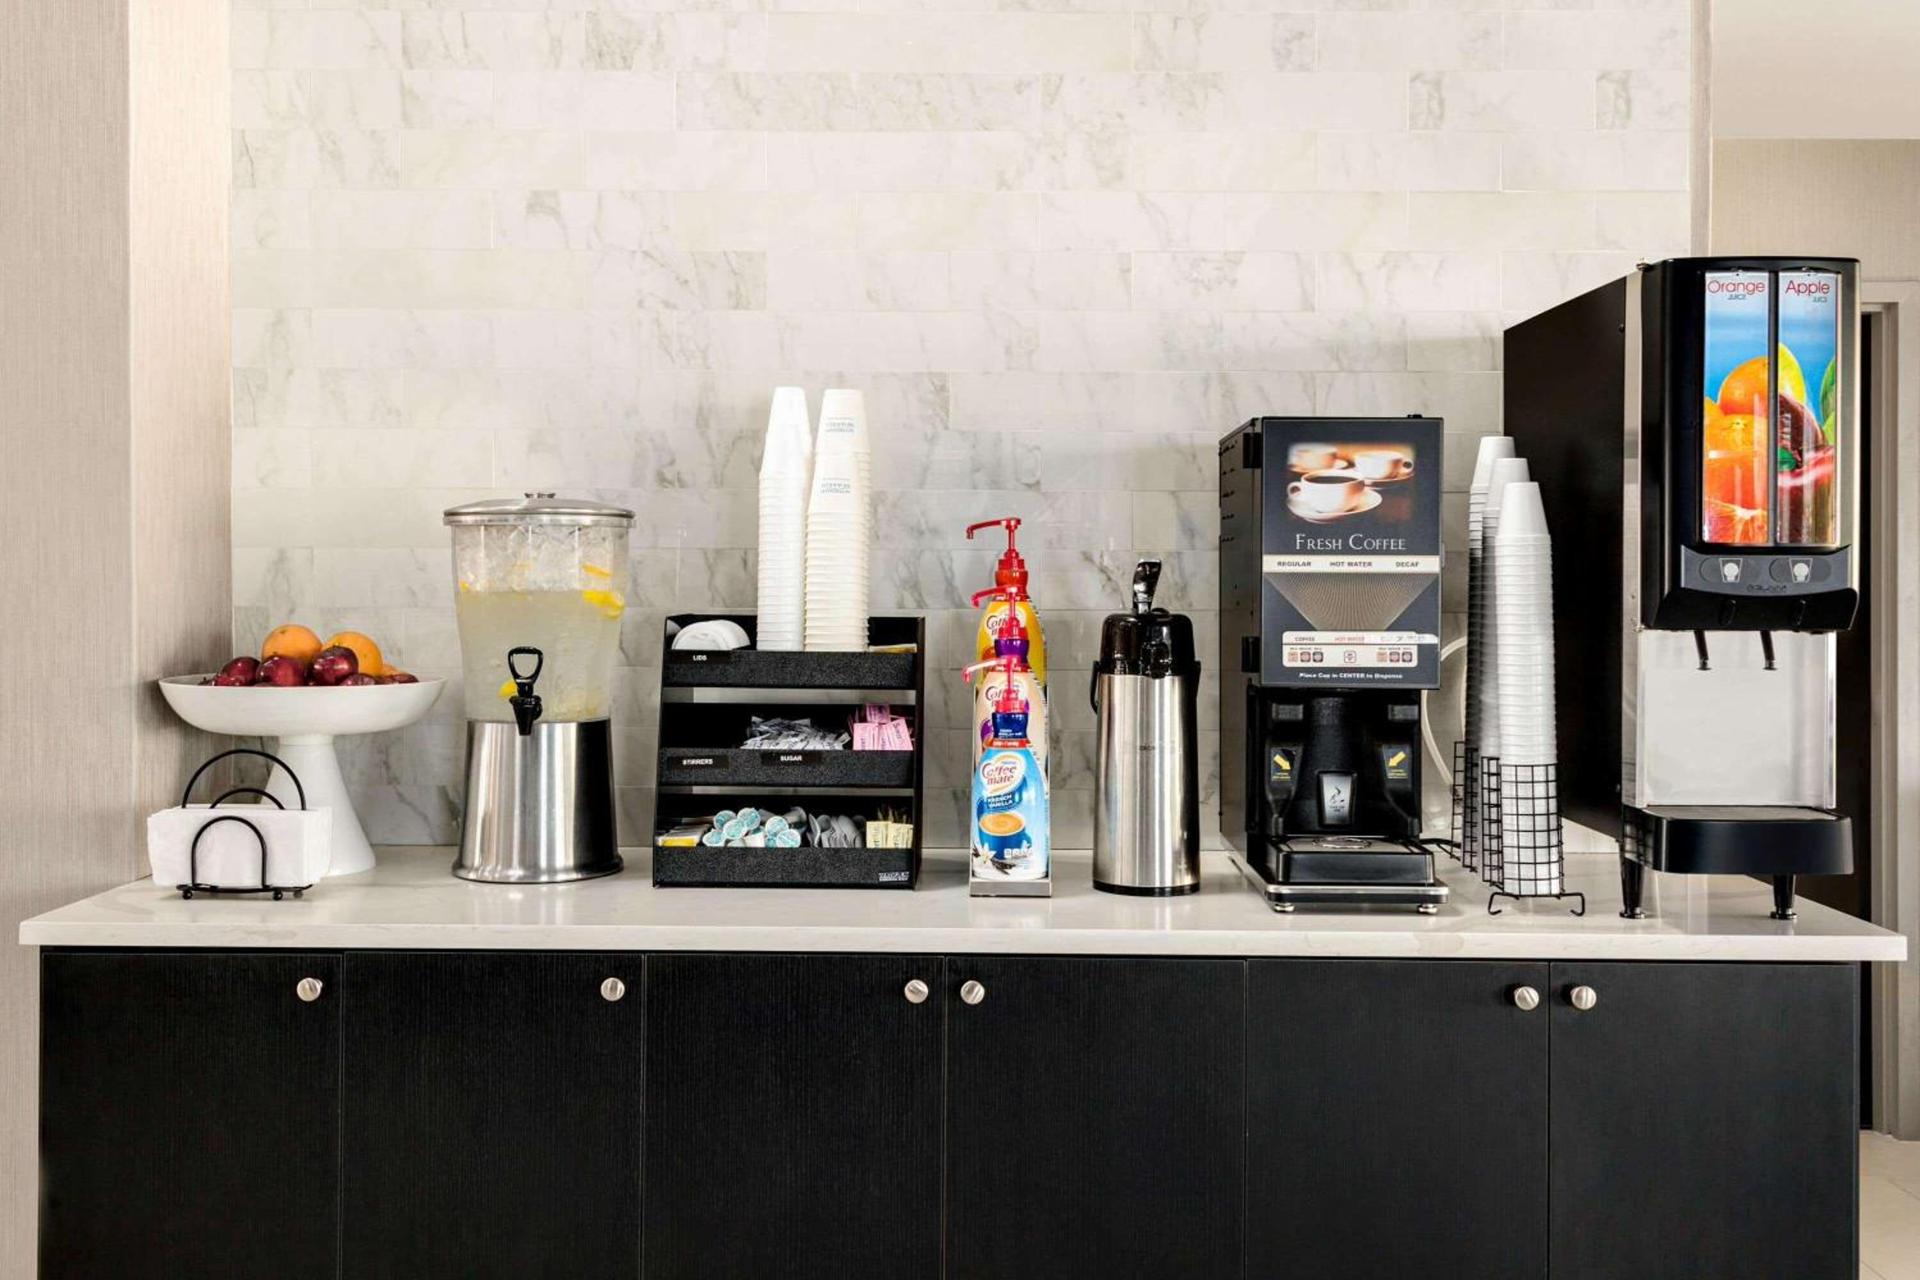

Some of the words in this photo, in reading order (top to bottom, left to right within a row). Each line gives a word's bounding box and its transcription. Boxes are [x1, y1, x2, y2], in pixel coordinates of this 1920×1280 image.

[1707, 280, 1766, 295] Orange
[1785, 280, 1830, 296] Apple
[1295, 533, 1342, 550] FRESH
[1349, 533, 1408, 550] COFFEE
[982, 762, 1017, 779] Coffee
[987, 774, 1014, 786] mate
